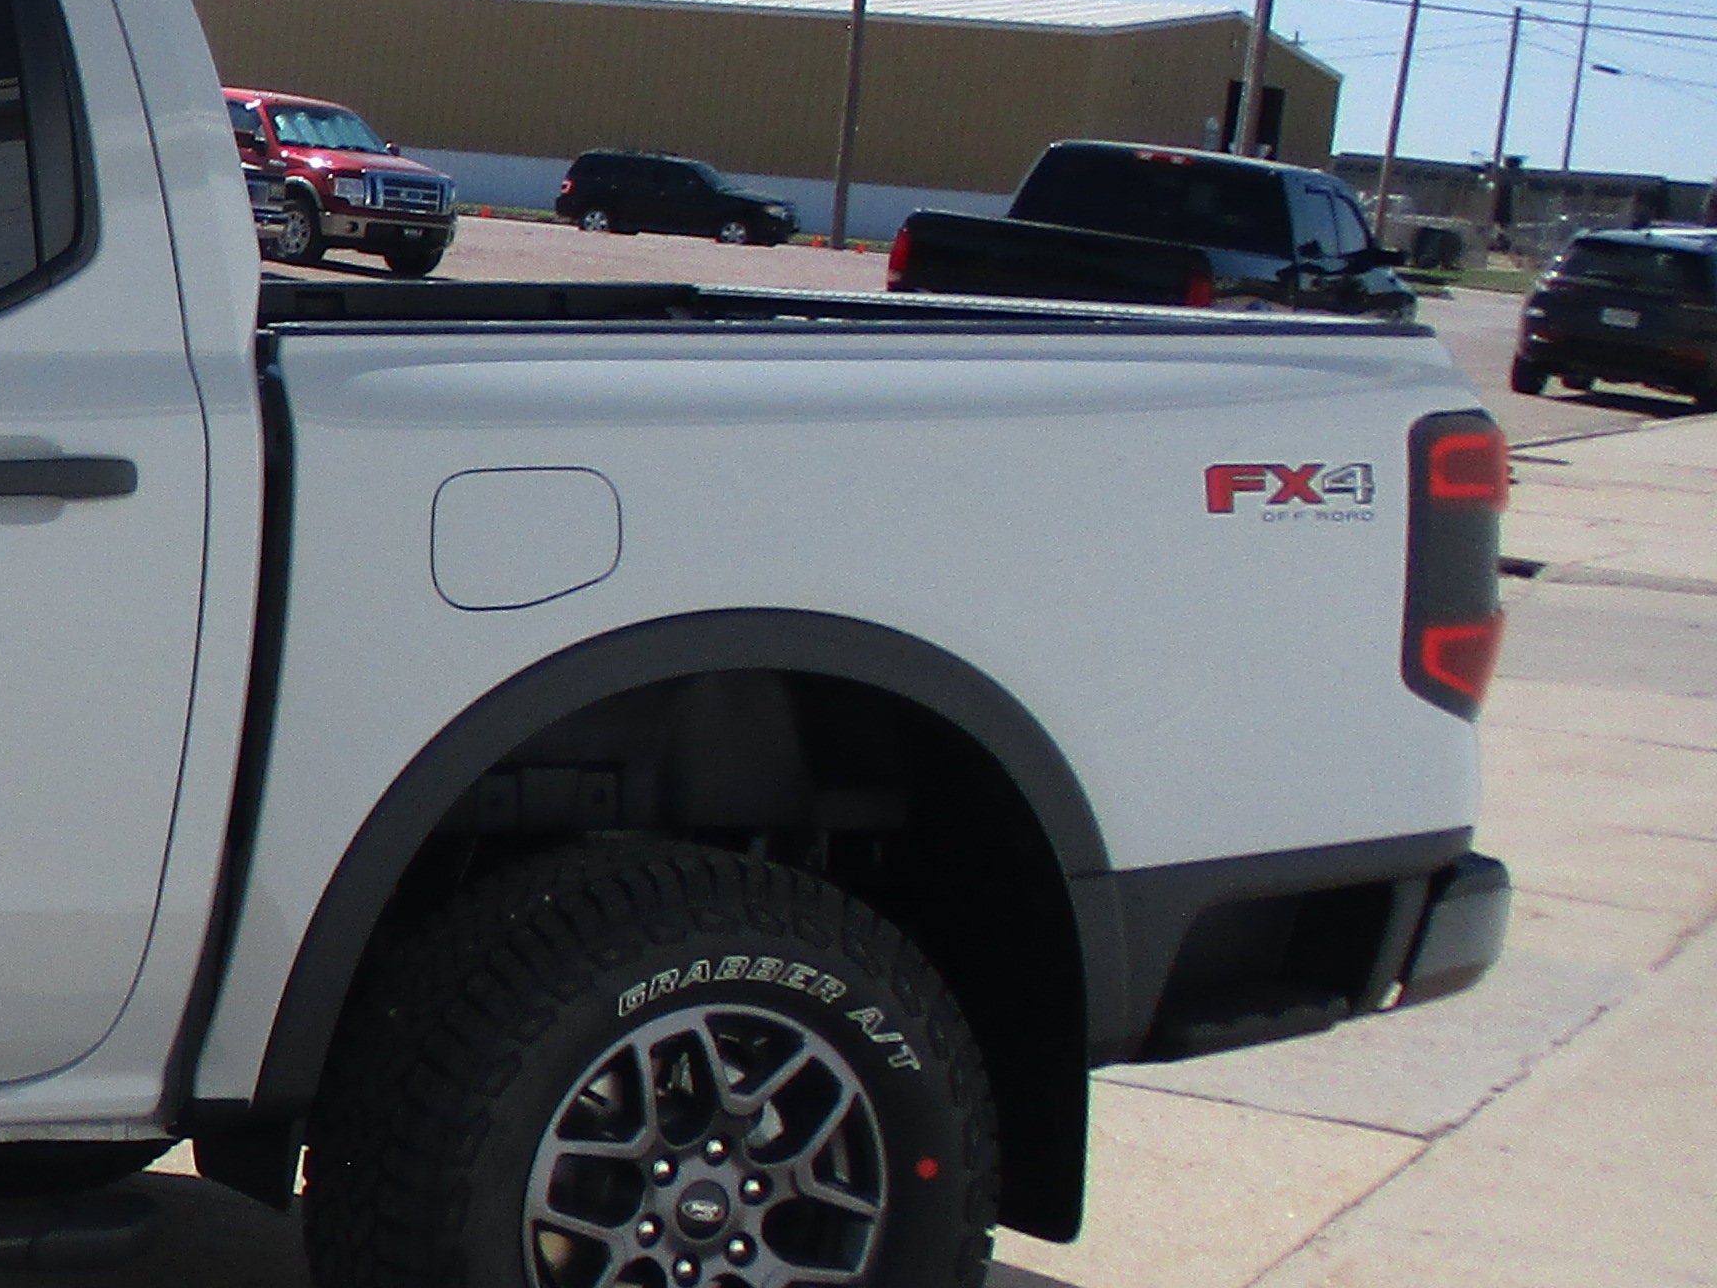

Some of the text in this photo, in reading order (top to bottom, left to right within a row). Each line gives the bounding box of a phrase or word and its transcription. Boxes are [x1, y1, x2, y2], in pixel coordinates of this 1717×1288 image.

[1205, 464, 1374, 513] FX4
[618, 955, 921, 1071] GRABBER A/T
